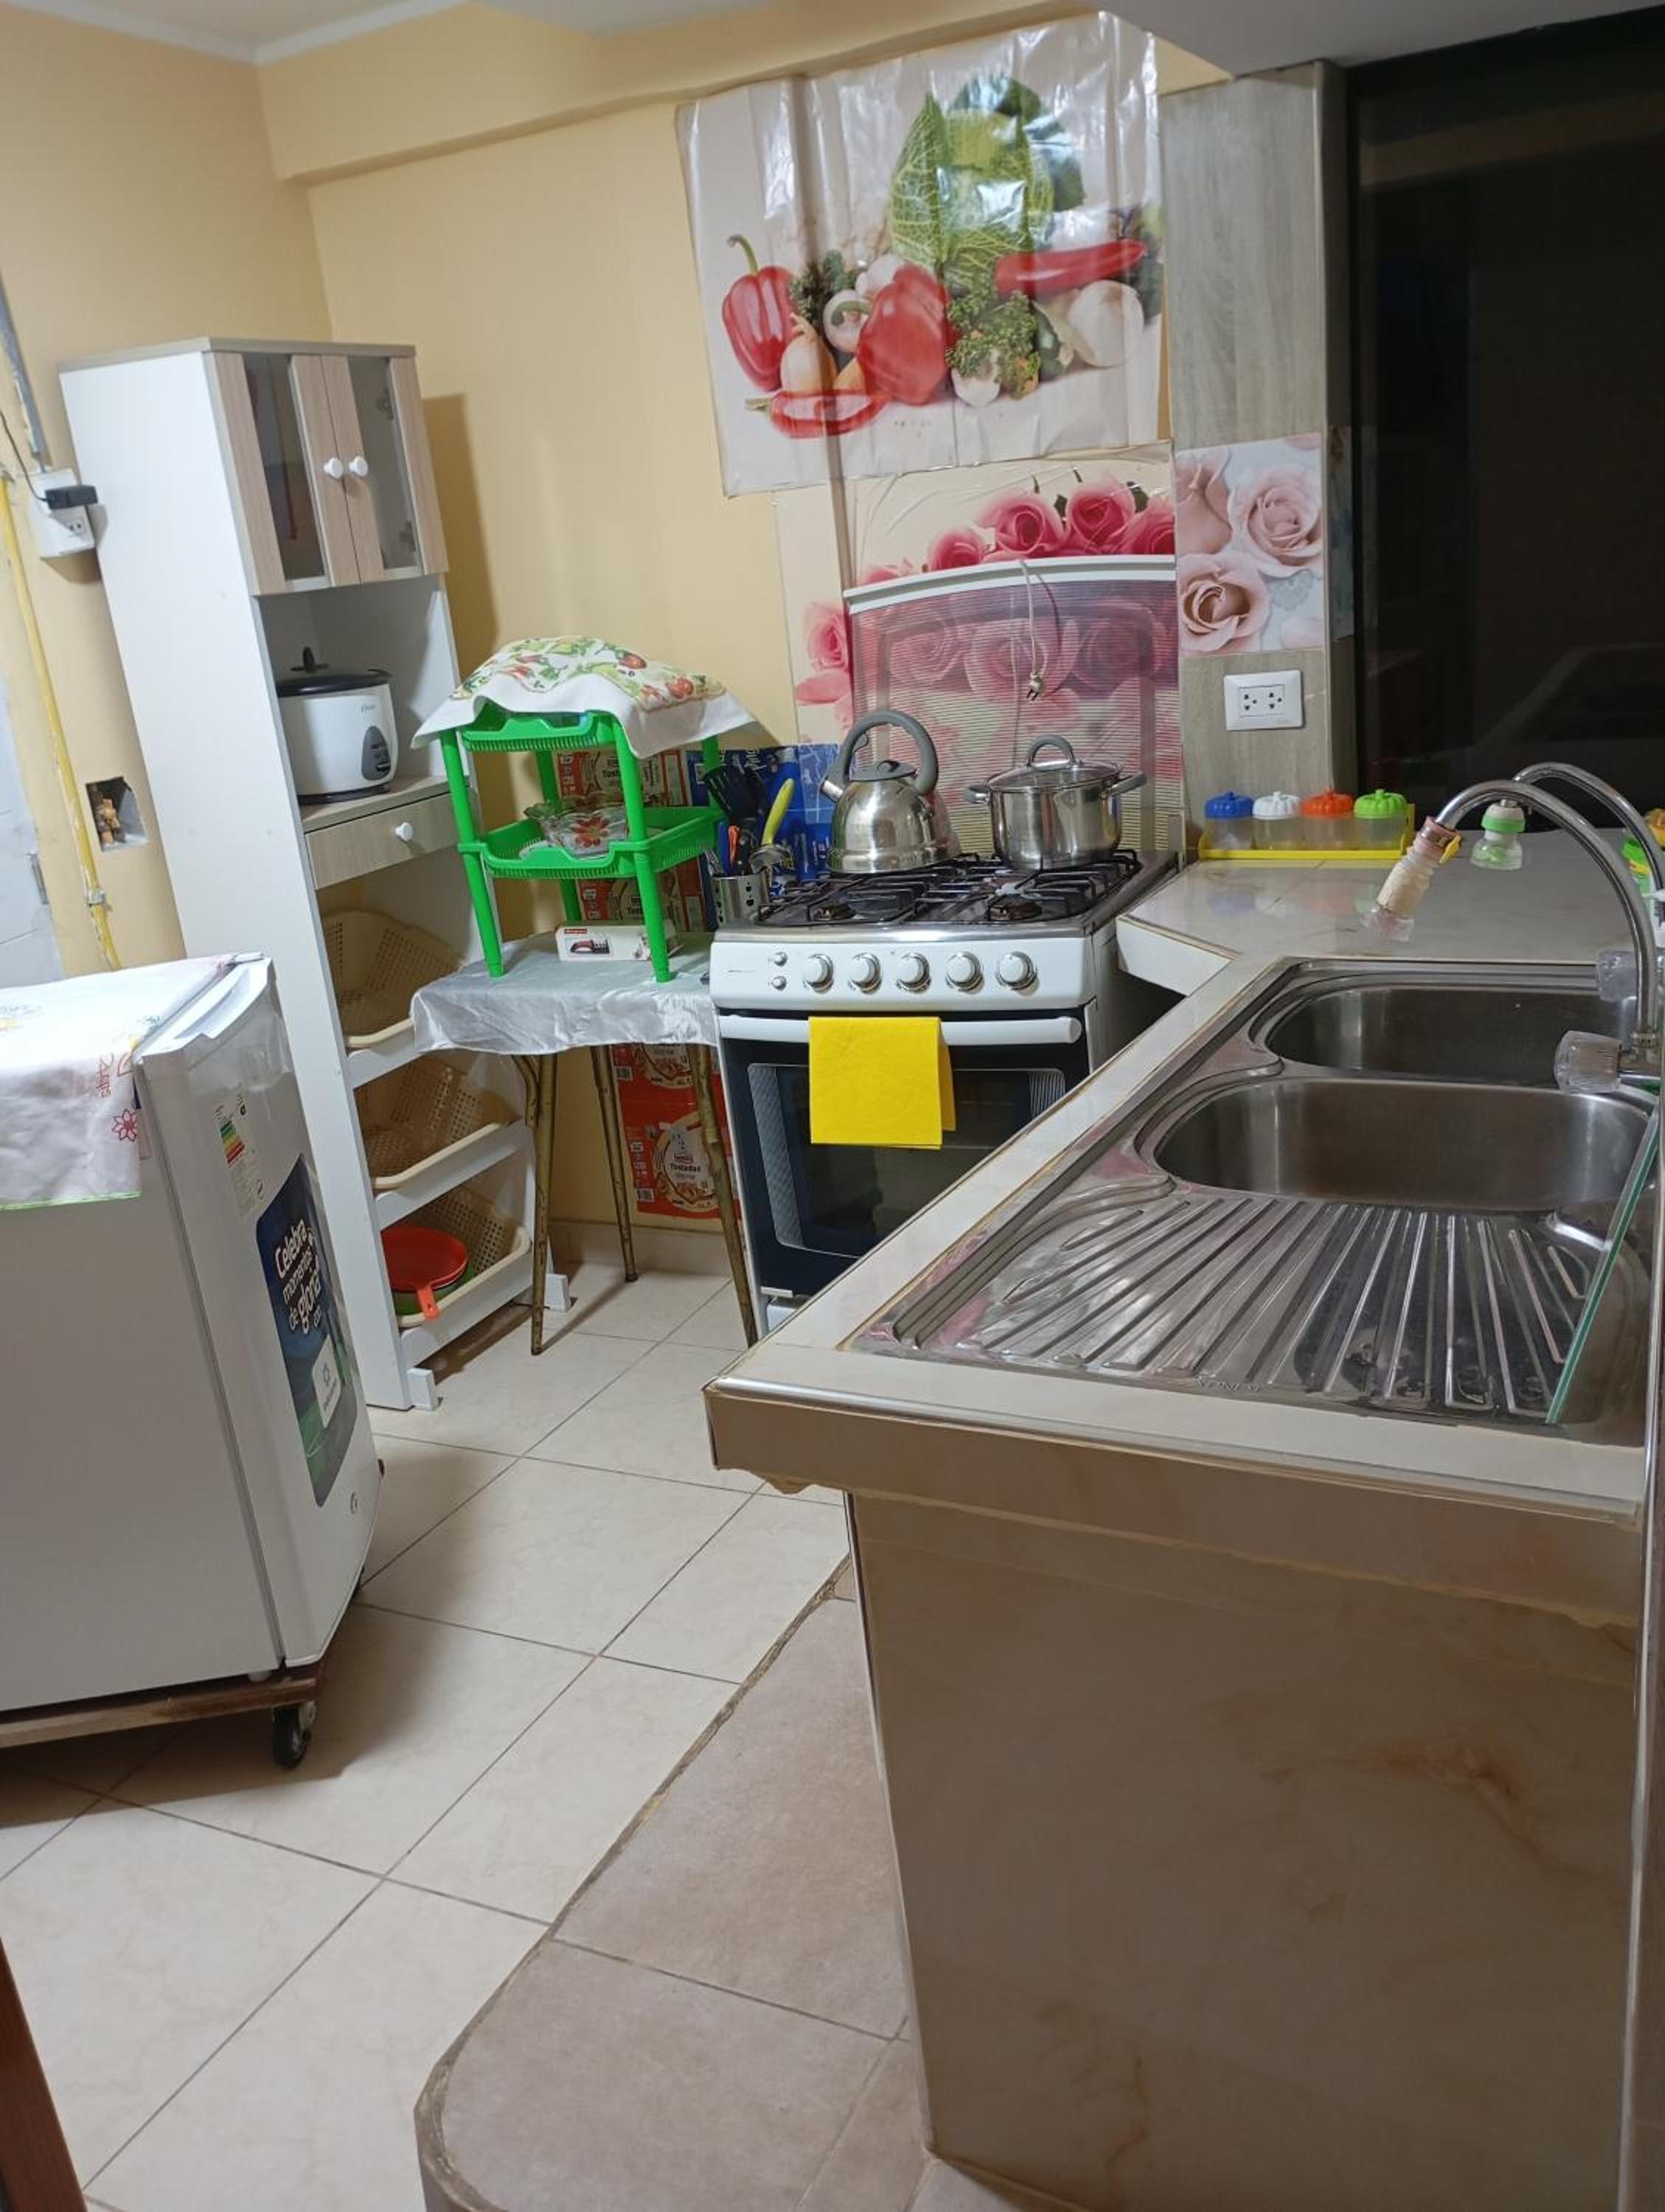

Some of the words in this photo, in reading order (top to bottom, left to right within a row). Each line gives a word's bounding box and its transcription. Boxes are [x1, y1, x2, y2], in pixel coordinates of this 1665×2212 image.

[275, 1219, 307, 1279] Celebra
[282, 1249, 313, 1304] momentos
[289, 1307, 299, 1331] de
[298, 1267, 321, 1334] gloria
